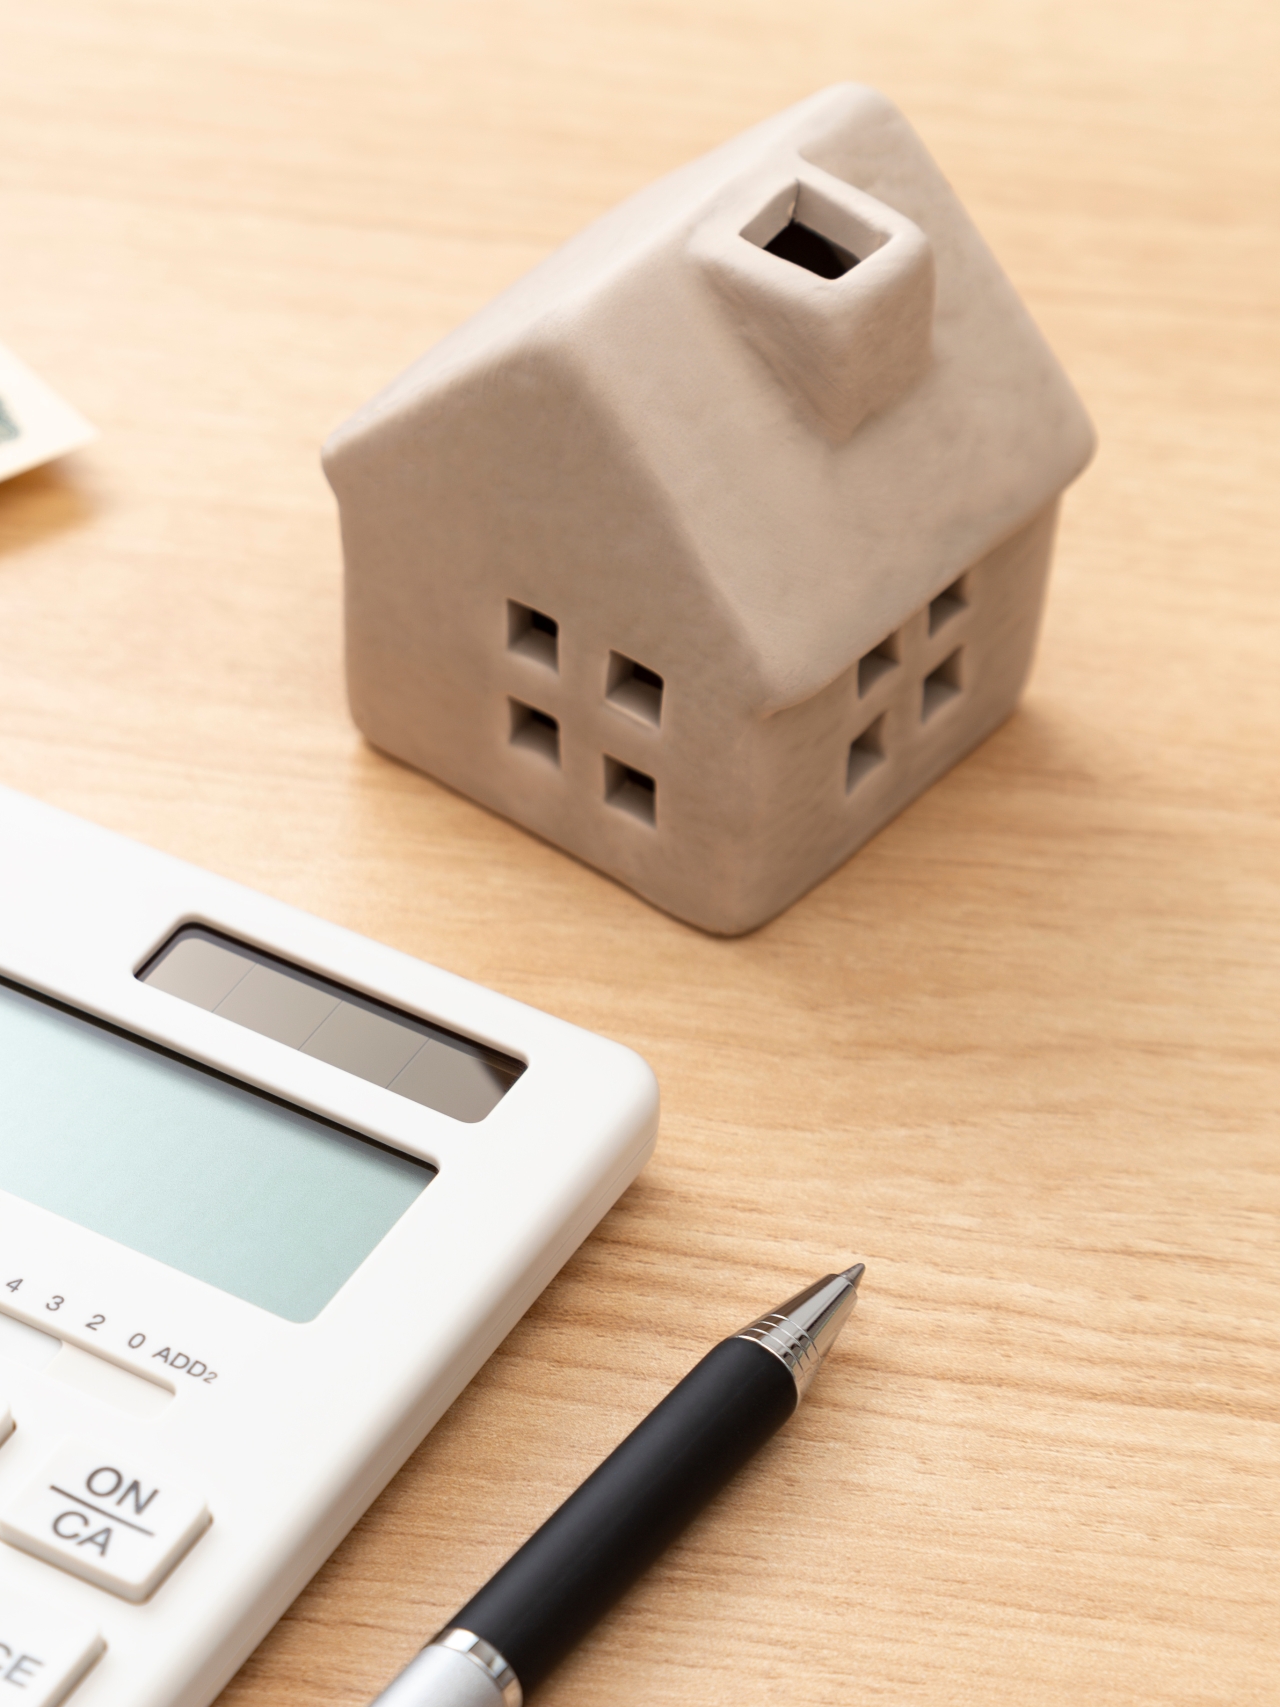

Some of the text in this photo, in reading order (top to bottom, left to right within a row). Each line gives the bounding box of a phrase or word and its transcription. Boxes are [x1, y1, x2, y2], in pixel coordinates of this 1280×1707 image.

[6, 1279, 23, 1292] 4
[45, 1295, 65, 1311] 3
[85, 1314, 106, 1331] 2
[128, 1333, 146, 1349] 0
[85, 1466, 159, 1515] ON
[51, 1511, 113, 1557] CA
